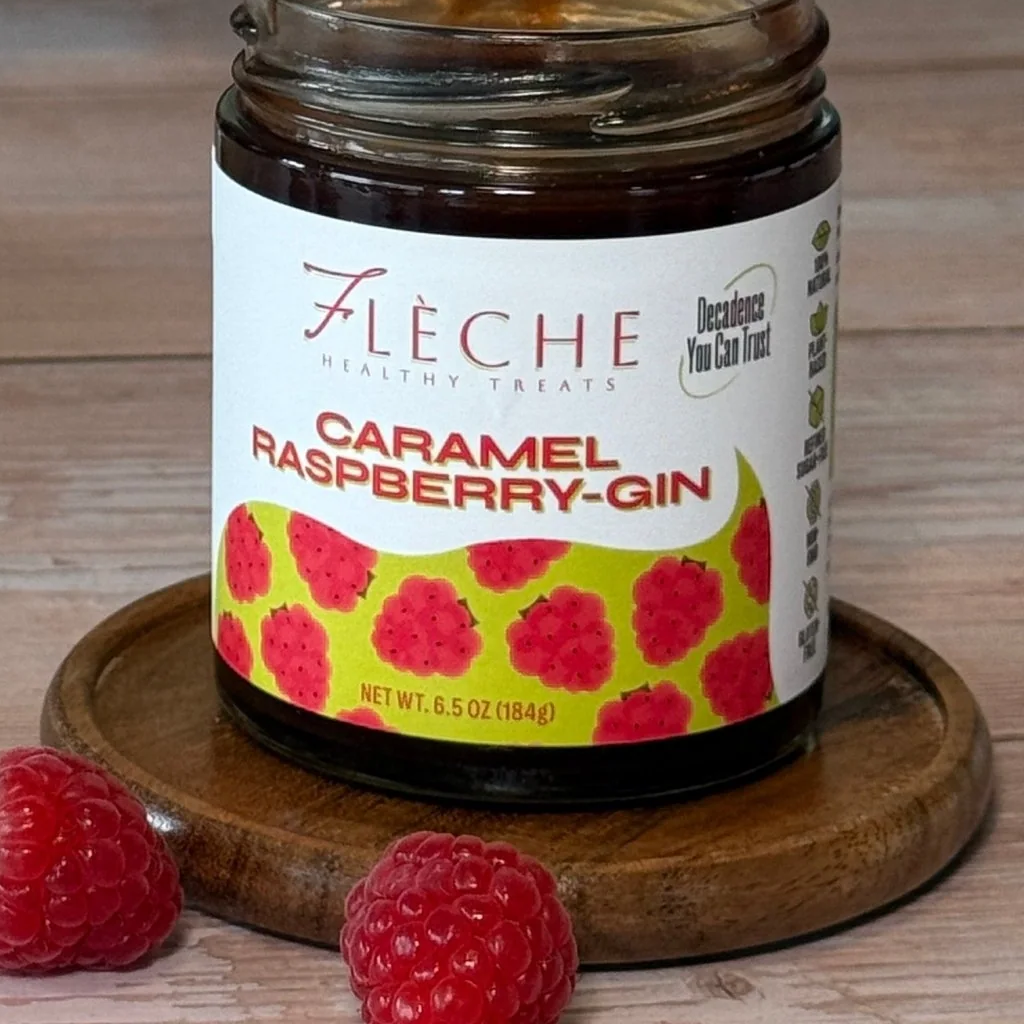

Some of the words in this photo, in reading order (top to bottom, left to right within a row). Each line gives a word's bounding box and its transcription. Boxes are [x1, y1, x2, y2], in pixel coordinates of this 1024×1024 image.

[303, 261, 641, 369] FLÈCHE
[696, 289, 765, 335] Decadence
[321, 353, 460, 389] HEALTHY
[489, 377, 617, 393] TREATS
[686, 336, 712, 374] You
[714, 331, 739, 370] Can
[741, 321, 772, 365] Trust
[315, 411, 620, 471] CARAMEL
[251, 424, 712, 513] RASPBERRY-GIN
[360, 682, 392, 707] NET
[396, 689, 430, 714] WT.
[433, 695, 463, 717] 6.5
[467, 698, 491, 720] OZ
[495, 700, 556, 726] (184g)
